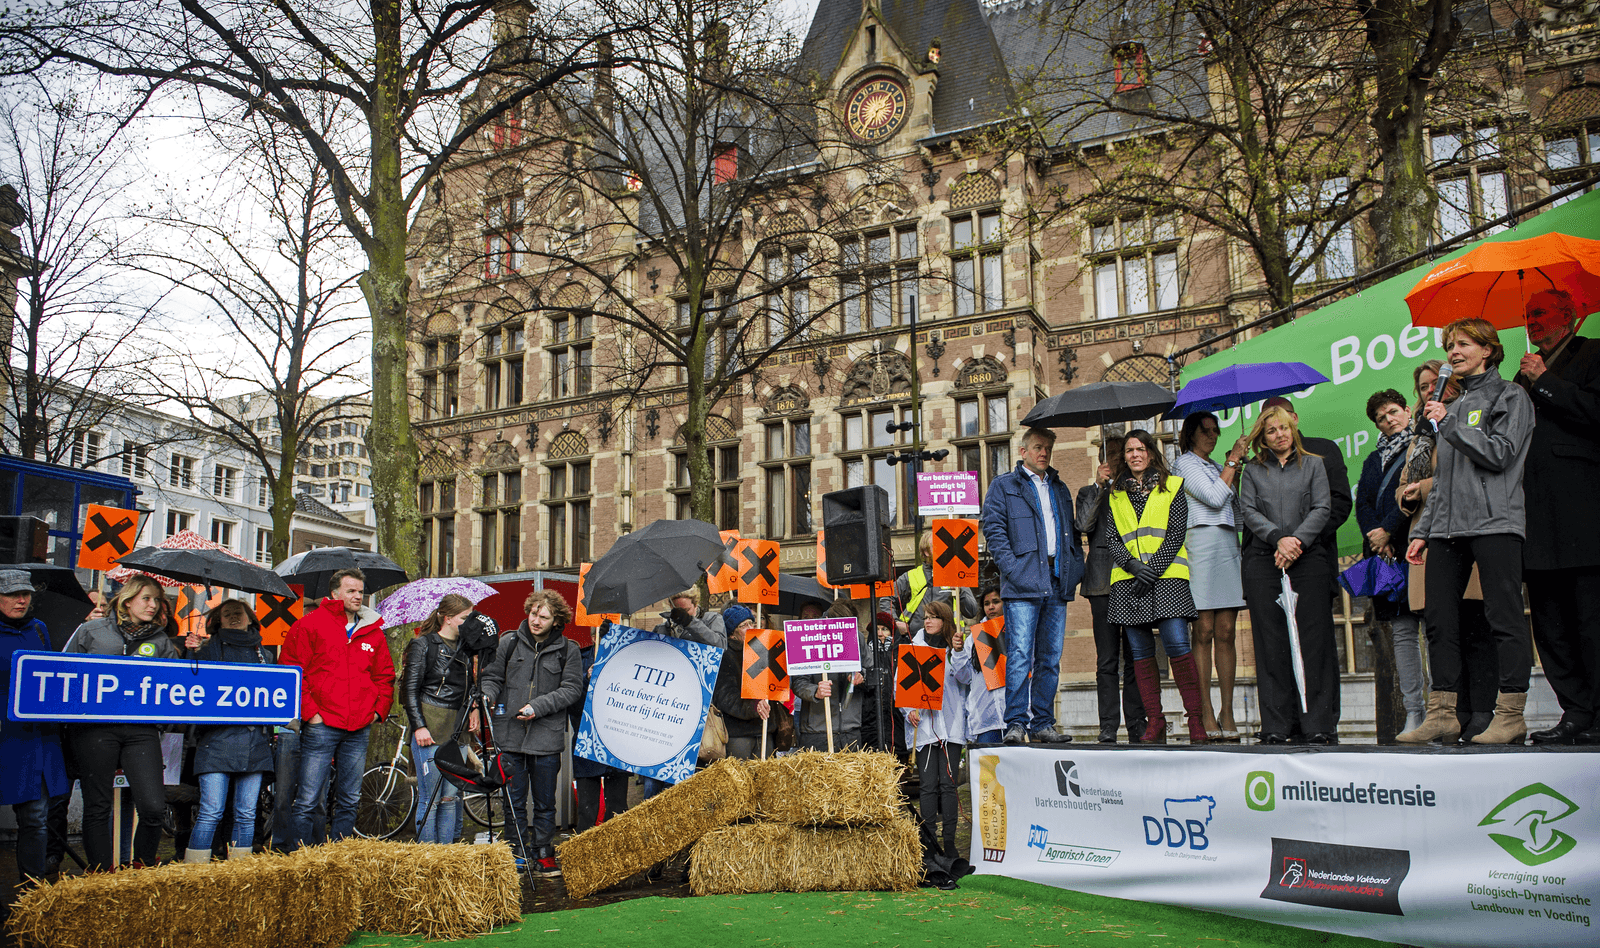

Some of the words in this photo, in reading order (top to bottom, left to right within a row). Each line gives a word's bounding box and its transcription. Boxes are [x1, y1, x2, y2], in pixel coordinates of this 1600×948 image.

[969, 372, 992, 384] 1880
[776, 400, 795, 411] 1876
[953, 473, 976, 481] milieu
[929, 482, 955, 490] eindigt
[956, 482, 966, 490] bij
[930, 491, 966, 504] TTIP
[786, 624, 803, 632] Een
[803, 622, 827, 631] beter
[828, 621, 855, 630] milieu
[800, 632, 831, 642] eindigt
[831, 631, 843, 642] bij
[801, 643, 844, 660] TTIP
[632, 663, 676, 688] TTIP
[32, 671, 206, 707] TTIP-free
[216, 685, 288, 708] zone
[606, 682, 620, 696] Als
[621, 686, 637, 698] een
[636, 687, 655, 702] boer
[656, 692, 670, 706] het
[670, 697, 690, 711] kent
[606, 696, 625, 709] Dan
[625, 704, 638, 712] eet
[639, 703, 651, 720] hij
[651, 707, 666, 720] het
[667, 713, 684, 725] niet
[1081, 786, 1122, 798] Nederlandse
[1281, 780, 1436, 807] milieudefensie
[1028, 828, 1048, 845] FNV
[1142, 815, 1210, 851] DDB
[984, 849, 1004, 861] NAV
[1045, 846, 1085, 861] Agrarisch
[1085, 851, 1112, 864] Groen
[1178, 852, 1202, 860] Dairymen
[1202, 854, 1218, 862] Board
[1308, 868, 1355, 883] Nederlandse
[1356, 874, 1391, 885] Vakbond
[1488, 869, 1539, 886] Vereniging
[1542, 874, 1567, 886] voor
[1304, 879, 1385, 897] Pluimveehouders
[1466, 883, 1592, 907] Biologisch-Dynamische
[1470, 900, 1525, 916] Landbouw
[1528, 908, 1542, 918] en
[1543, 908, 1591, 927] Voeding
